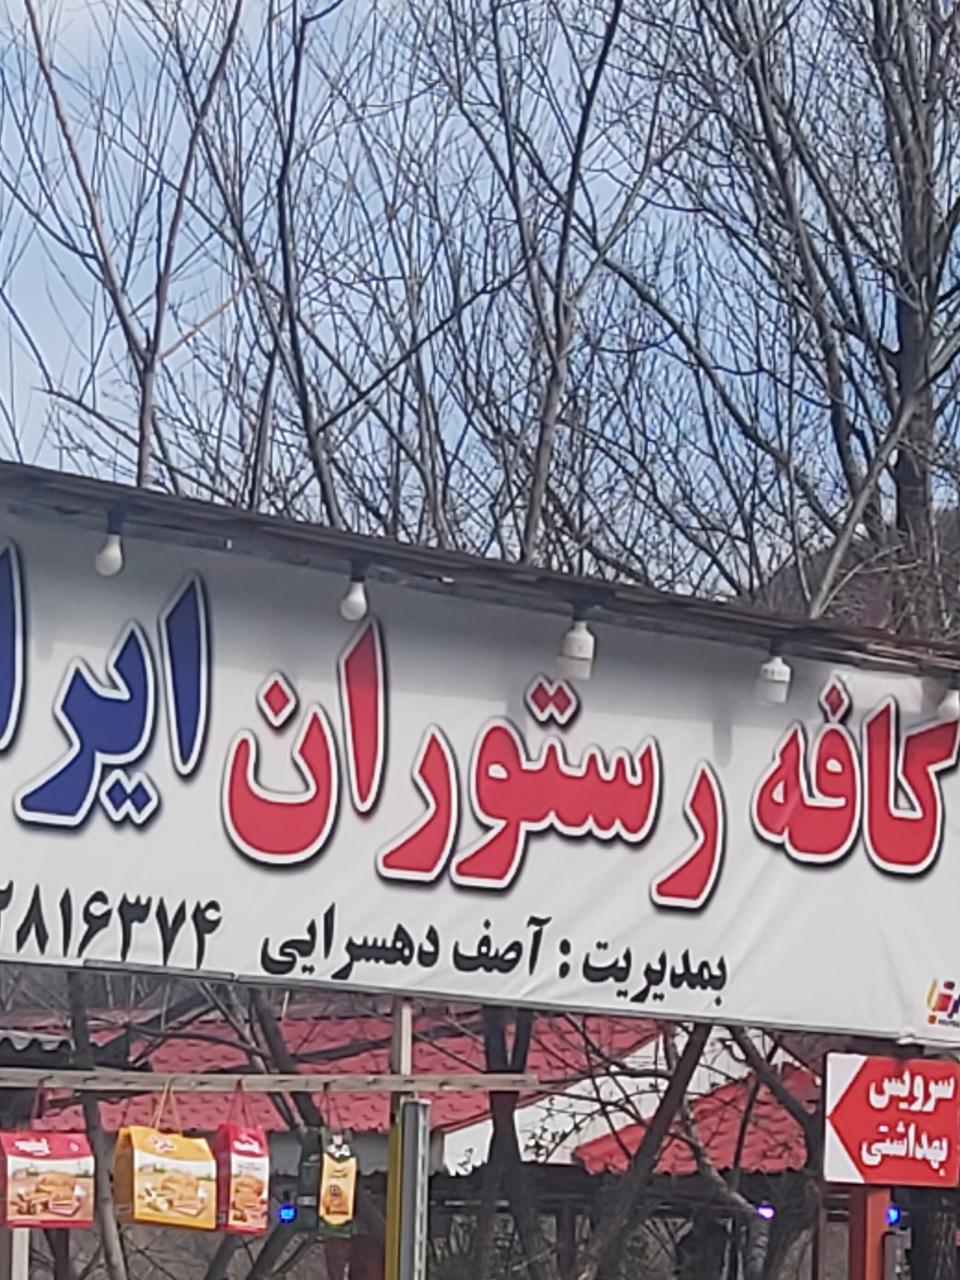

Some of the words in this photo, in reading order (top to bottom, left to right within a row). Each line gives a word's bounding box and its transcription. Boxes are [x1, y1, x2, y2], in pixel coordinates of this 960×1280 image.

[225, 619, 724, 902] رستوران
[753, 679, 960, 869] کافه
[259, 902, 440, 981] دهسرایی
[452, 915, 552, 977] آصف
[868, 1069, 956, 1113] سرویس
[860, 1120, 949, 1177] بهداشتی
